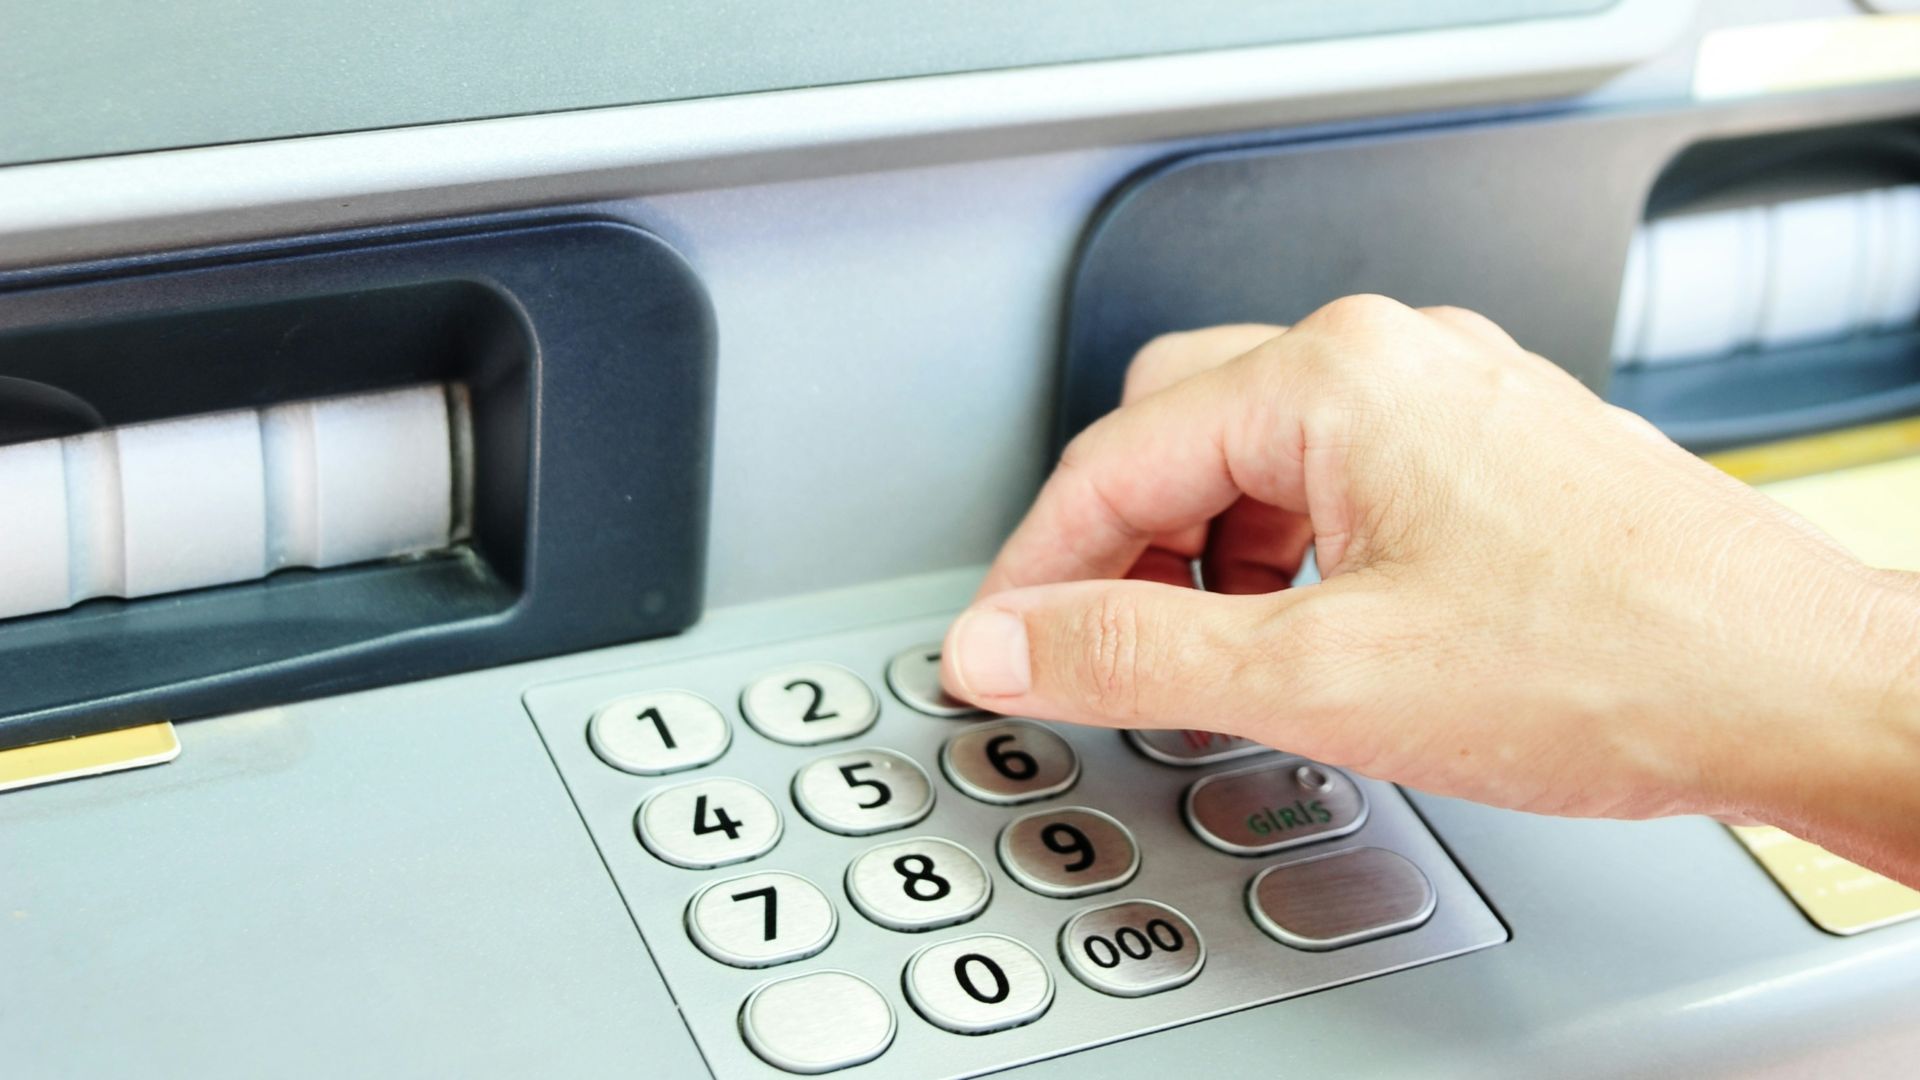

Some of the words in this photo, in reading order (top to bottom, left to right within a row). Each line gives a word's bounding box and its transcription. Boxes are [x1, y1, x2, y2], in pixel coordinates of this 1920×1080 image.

[785, 680, 838, 723] 2
[636, 707, 677, 750] 1
[985, 734, 1040, 782] 6
[838, 761, 893, 810] 5
[692, 795, 743, 840] 4
[1040, 822, 1096, 873] 9
[892, 854, 951, 902] 8
[731, 886, 778, 942] 7
[1083, 918, 1184, 969] 000
[953, 953, 1011, 1005] 0
